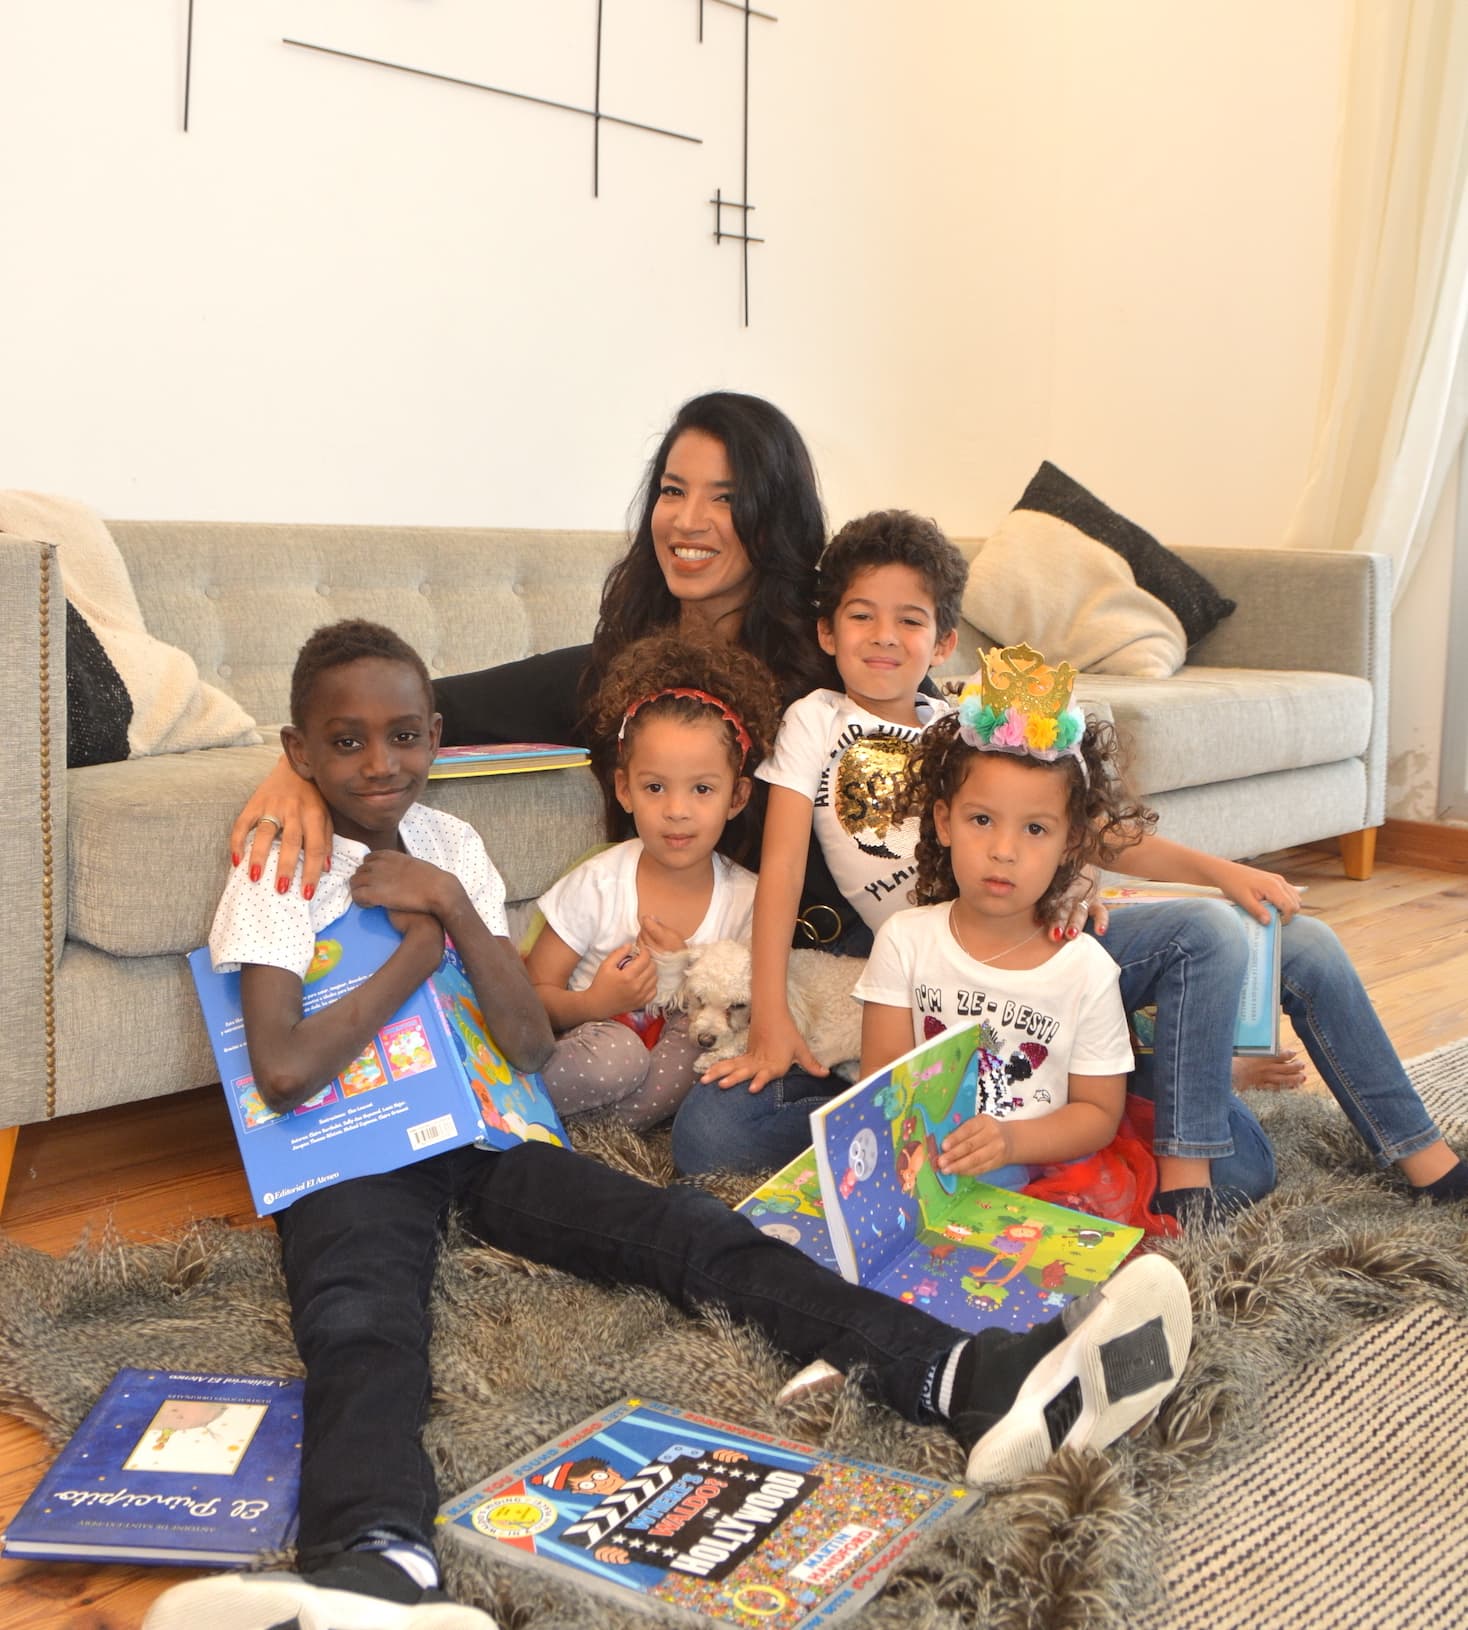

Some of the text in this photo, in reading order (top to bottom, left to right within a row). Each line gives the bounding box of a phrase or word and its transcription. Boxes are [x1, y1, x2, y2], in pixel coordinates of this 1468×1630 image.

[915, 984, 942, 1012] I'M
[274, 1183, 305, 1200] Editorial
[306, 1178, 315, 1189] El
[316, 1171, 339, 1185] Ateneo
[168, 1374, 208, 1383] Ateneo
[207, 1376, 222, 1384] El
[223, 1377, 275, 1387] Editorial
[684, 1412, 775, 1443] SOMEWHERE
[779, 1439, 814, 1453] NEW
[838, 1456, 888, 1473] EVERY
[448, 1493, 484, 1515] HAVE
[484, 1475, 513, 1493] YOU
[513, 1448, 559, 1477] FOUND
[558, 1422, 603, 1448] WALDO
[54, 1488, 269, 1520] El Principito
[624, 1472, 704, 1530] WHERE'S
[648, 1477, 728, 1537] WALDO?
[703, 1507, 720, 1519] IN
[670, 1470, 805, 1576] HOLLYWOOD
[804, 1533, 851, 1568] MARTIN
[808, 1530, 873, 1581] HANDFORD
